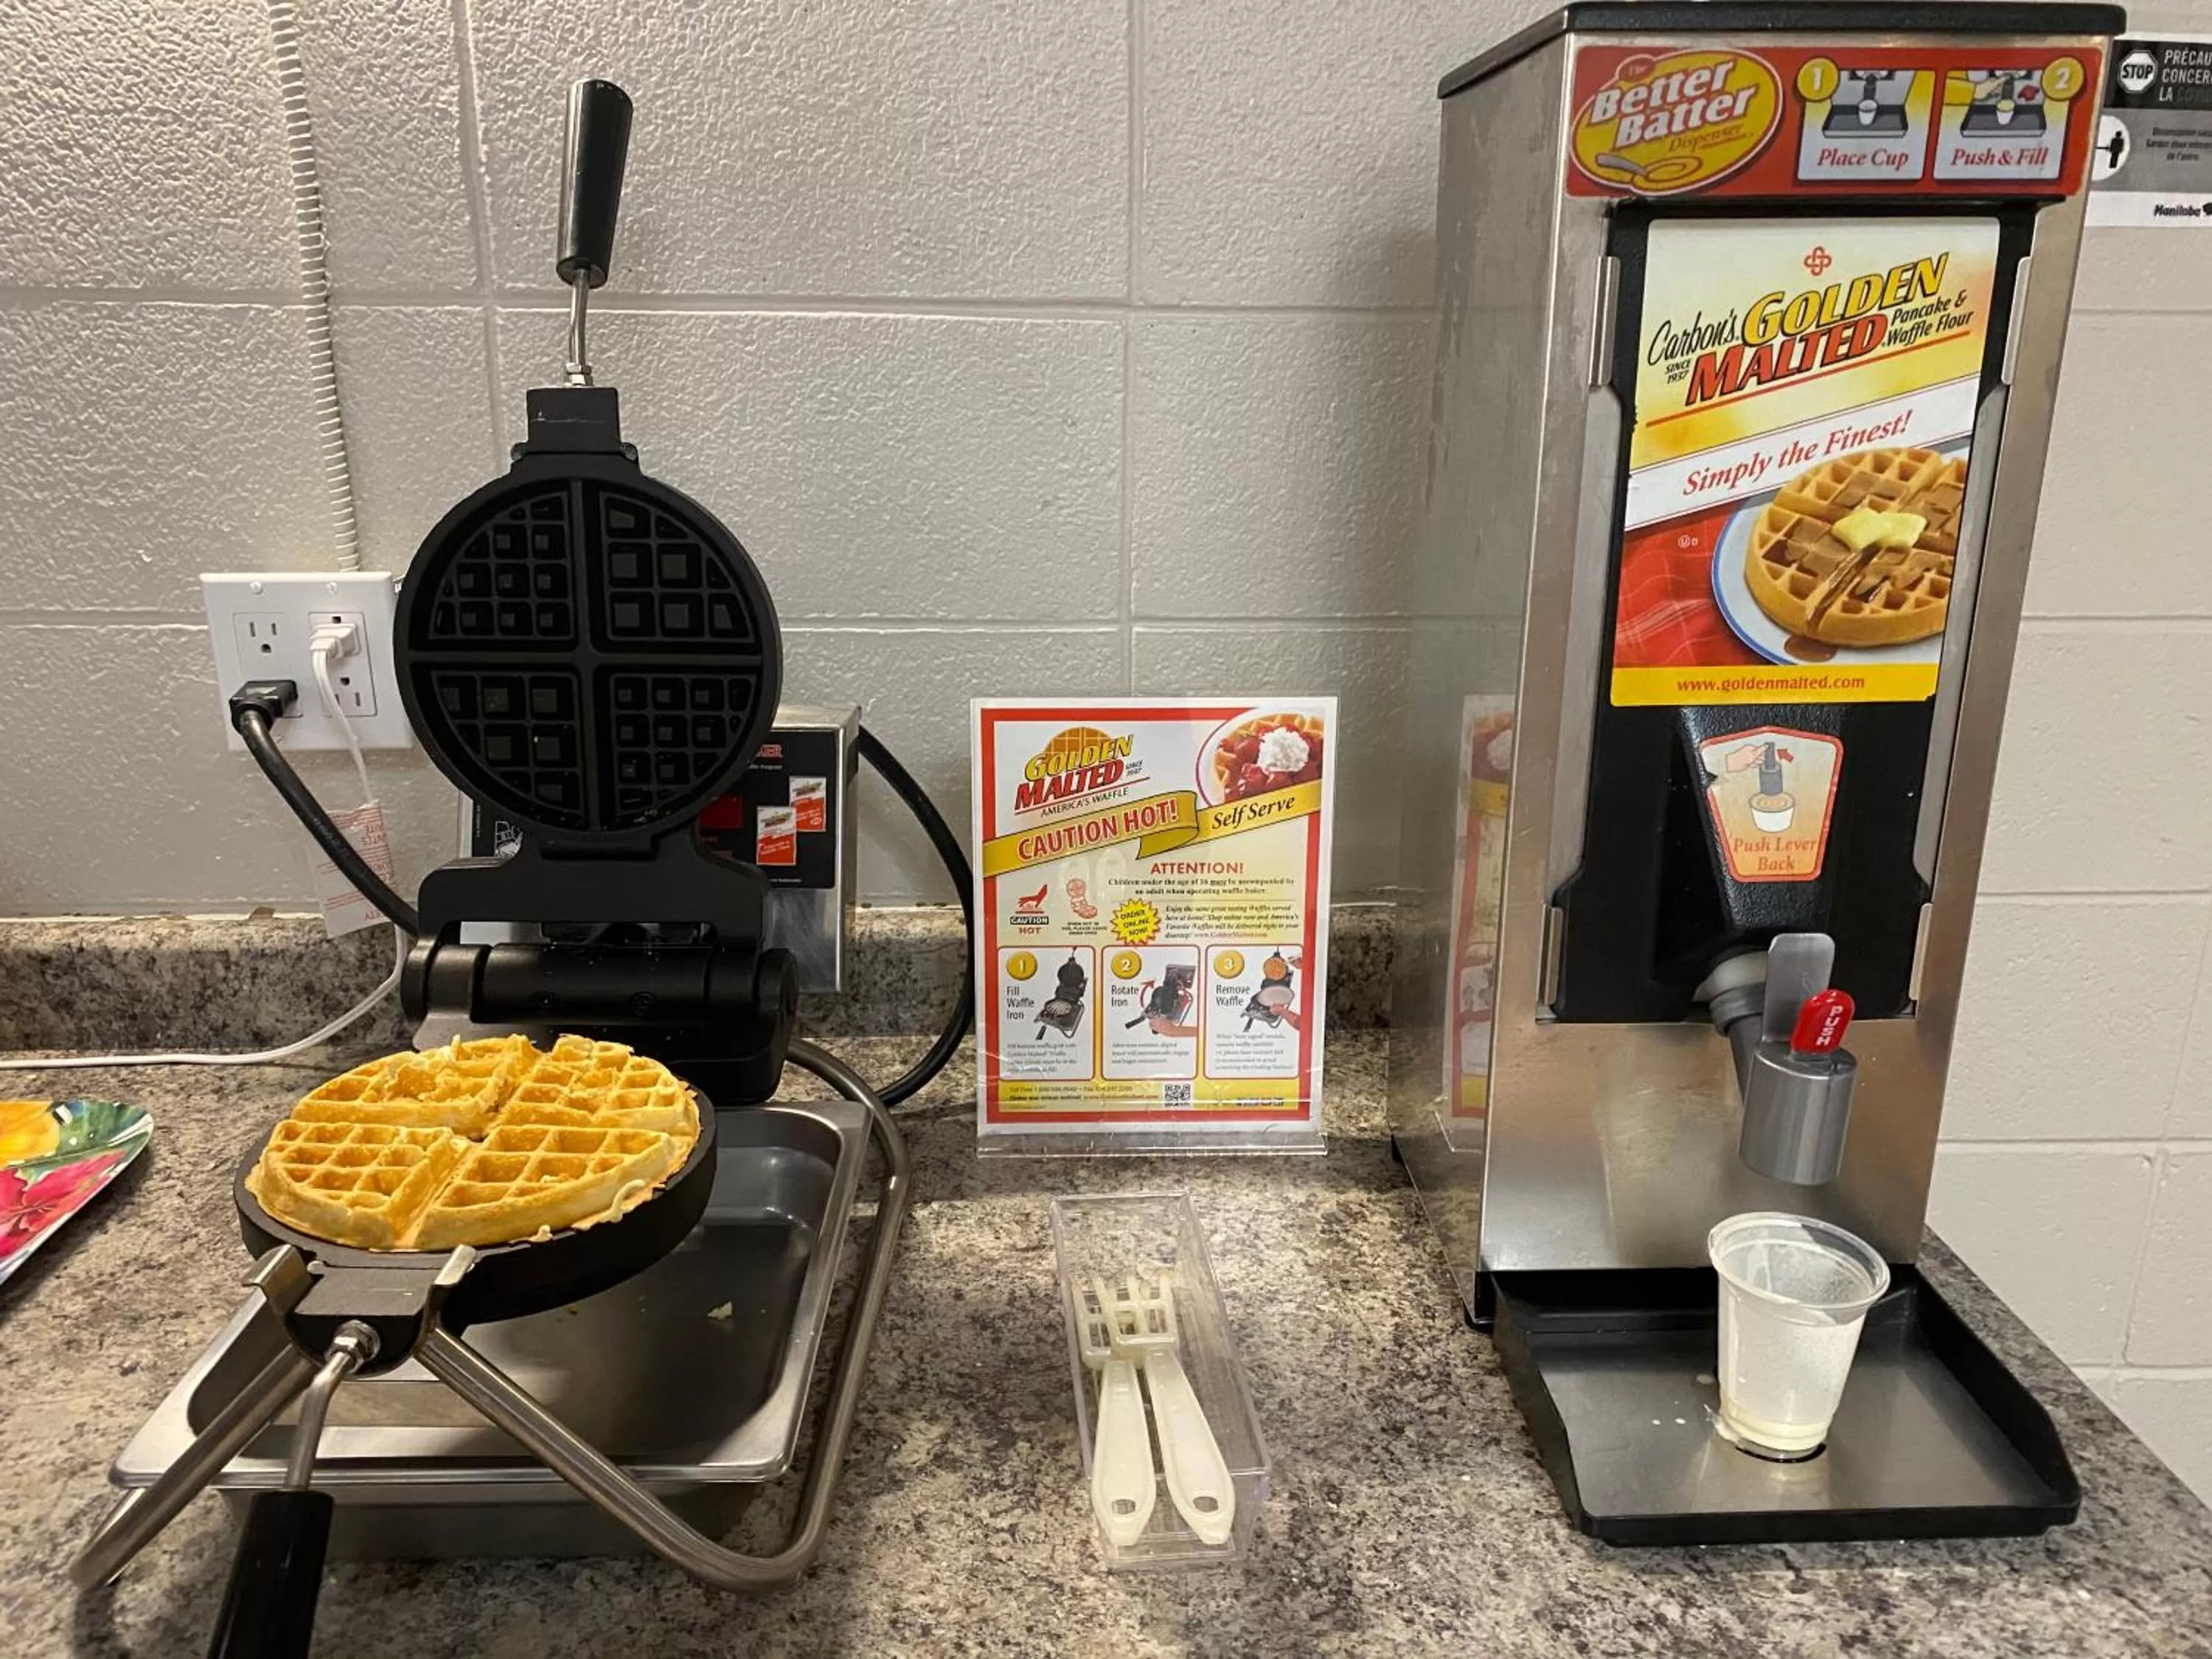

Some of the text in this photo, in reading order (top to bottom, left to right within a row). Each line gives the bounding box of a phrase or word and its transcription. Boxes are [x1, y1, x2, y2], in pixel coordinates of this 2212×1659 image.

[1811, 67, 1823, 92] 1
[2055, 68, 2071, 91] 2
[2121, 64, 2153, 79] STOP
[2161, 68, 2212, 84] CONCER
[1588, 59, 1736, 125] Better
[2159, 85, 2173, 102] LA
[1613, 85, 1757, 150] Batter
[1669, 125, 1744, 152] Dispenser
[1818, 147, 1909, 171] Place Cup
[1950, 147, 2048, 167] Push & Fill
[2153, 204, 2201, 217] Manitoba
[1647, 251, 1950, 366] Carbon's GOLDEN
[1891, 288, 1968, 326] Pancake &
[1887, 310, 1975, 347] Waffle Flour
[1665, 358, 1691, 375] SINCE
[1686, 313, 1889, 406] MALTED
[1666, 369, 1689, 384] 1937
[1683, 409, 1913, 496] Simply the Finest!
[1676, 675, 1865, 692] www.goldenmalted.com
[1024, 734, 1134, 782] GOLDEN
[1015, 759, 1124, 810] MALTED
[1040, 787, 1129, 817] AMERICA'S WAFFLE
[1212, 796, 1295, 829] Self Serve
[1018, 798, 1178, 860] CAUTION HOT!
[1733, 837, 1818, 852] Push Lever
[1150, 862, 1244, 874] ATTENTION!
[1757, 855, 1796, 871] Back
[1019, 959, 1026, 973] 1
[1121, 959, 1131, 973] 2
[1006, 986, 1020, 996] Fill
[1111, 985, 1139, 995] Rotate
[1216, 985, 1251, 995] Remove
[1006, 998, 1035, 1008] Waffle
[1111, 997, 1128, 1007] Iron
[1216, 995, 1244, 1006] Waffle
[1006, 1009, 1024, 1020] Iron
[1815, 1004, 1843, 1046] PUSH
